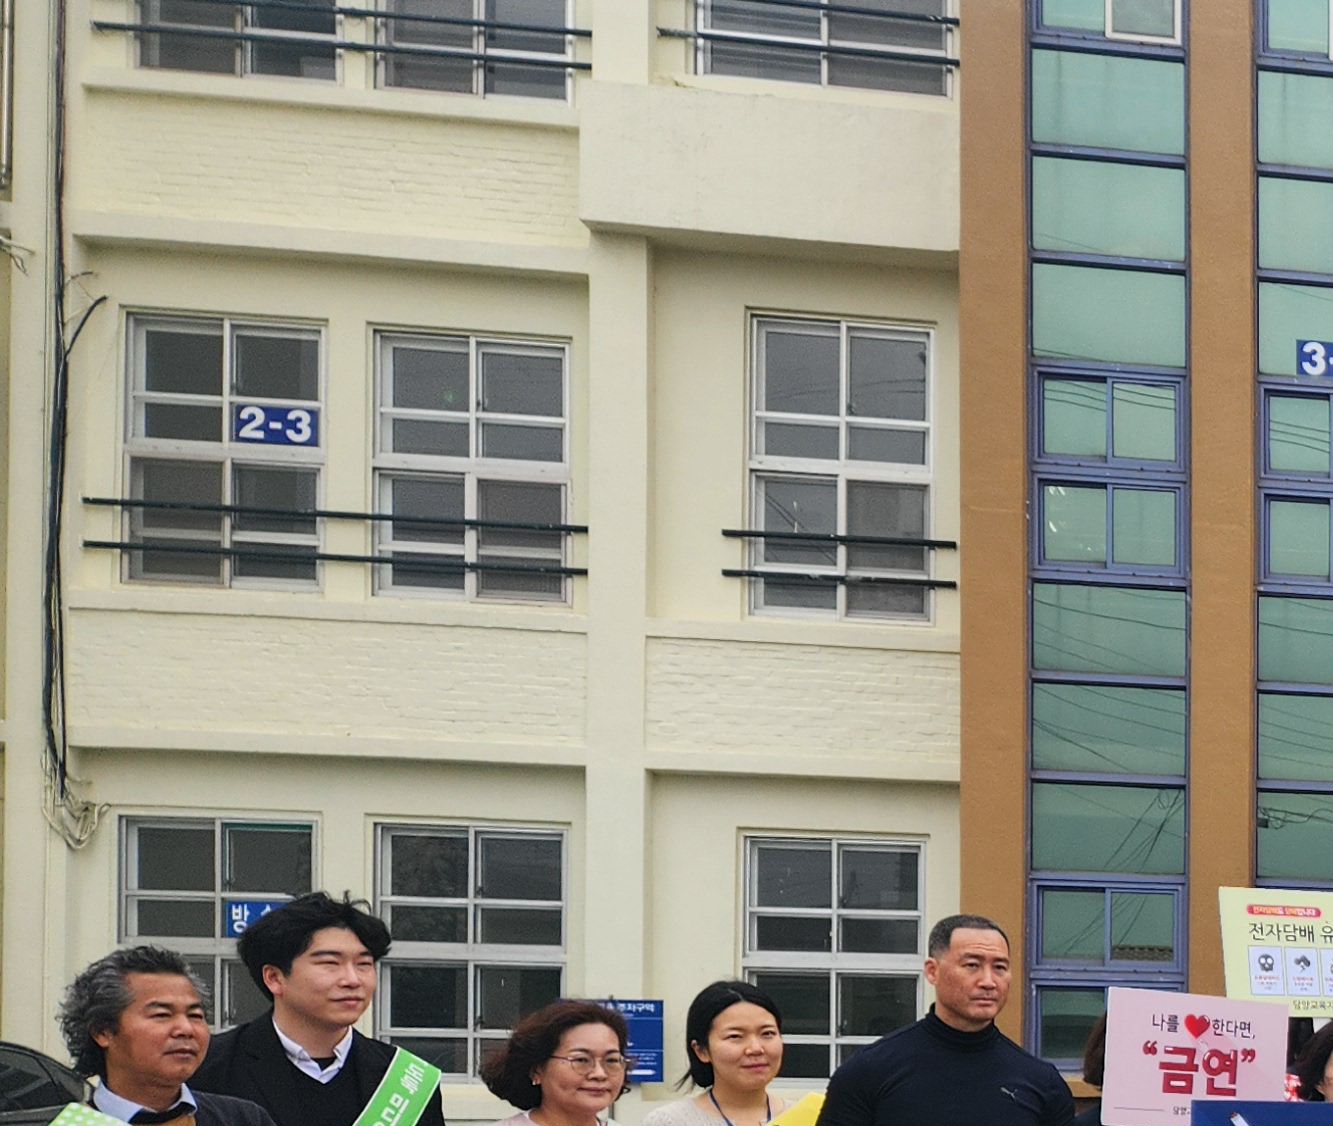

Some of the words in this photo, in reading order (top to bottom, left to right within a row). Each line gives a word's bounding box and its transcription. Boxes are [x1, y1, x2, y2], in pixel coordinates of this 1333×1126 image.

[239, 406, 312, 442] 2-3
[1249, 922, 1315, 943] 전자담배
[1152, 1013, 1180, 1032] 나를
[1212, 1019, 1256, 1040] 한다면,
